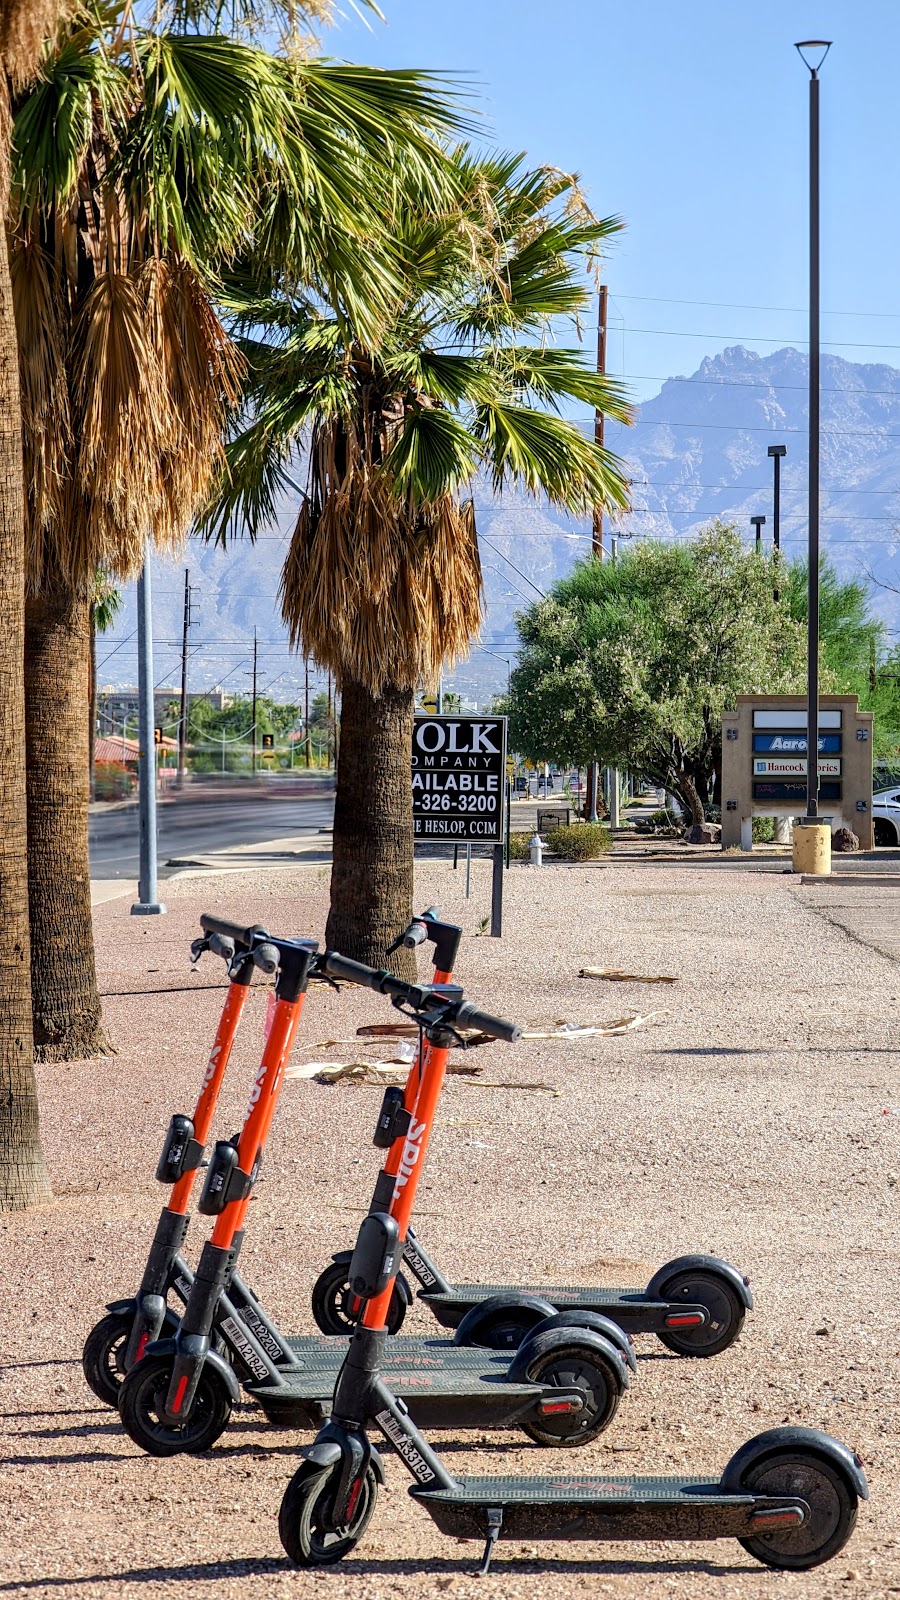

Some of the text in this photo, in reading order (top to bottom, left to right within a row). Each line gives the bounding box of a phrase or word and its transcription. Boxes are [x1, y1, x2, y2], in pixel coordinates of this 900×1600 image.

[413, 722, 500, 754] OLK
[411, 756, 492, 768] OMPANY
[768, 762, 804, 772] Hancock
[412, 773, 498, 792] AILABLE
[412, 793, 497, 812] -326-3200
[425, 820, 466, 837] HESLOP,
[469, 820, 497, 835] CCIM
[408, 1253, 435, 1286] A21761
[251, 1322, 281, 1359] A22200
[237, 1343, 269, 1380] A21842
[381, 1376, 432, 1386] PIN
[396, 1439, 432, 1482] A33194
